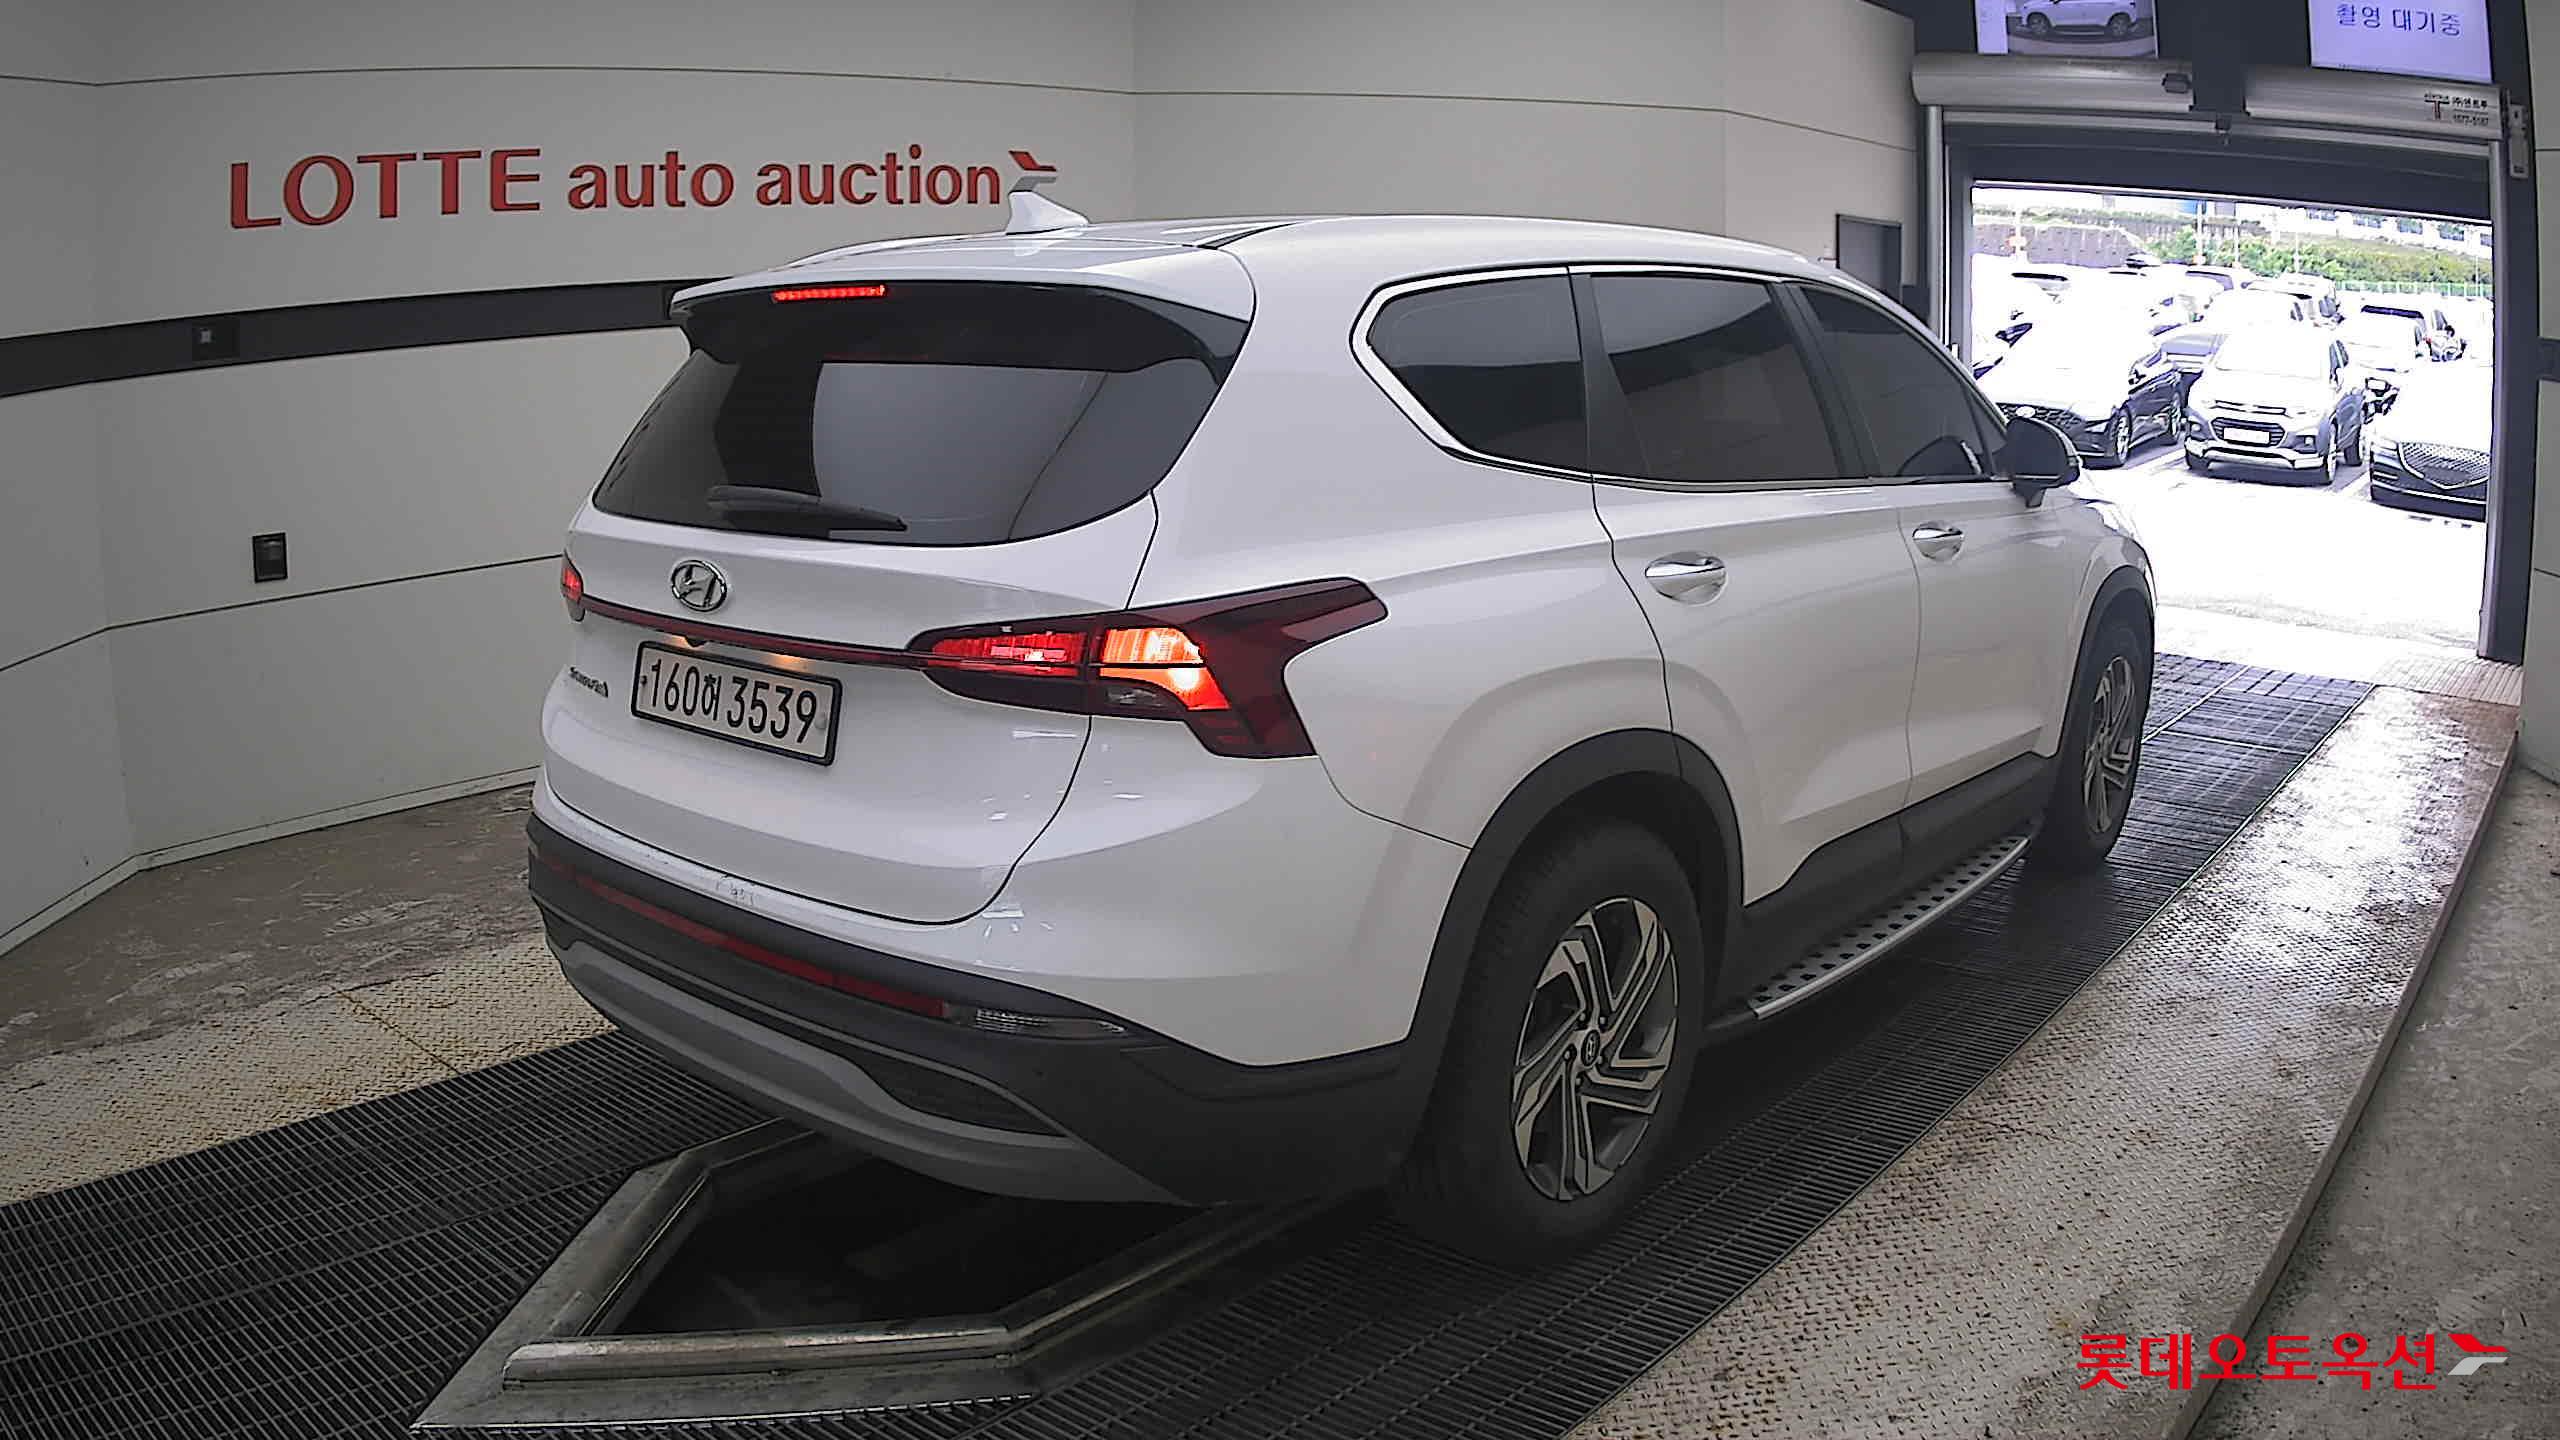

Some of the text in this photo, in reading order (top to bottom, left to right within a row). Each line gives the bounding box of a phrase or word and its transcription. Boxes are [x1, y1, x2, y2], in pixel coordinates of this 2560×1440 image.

[2337, 4, 2461, 37] 촬영 대기중
[230, 144, 1002, 229] LOTTE auto auction
